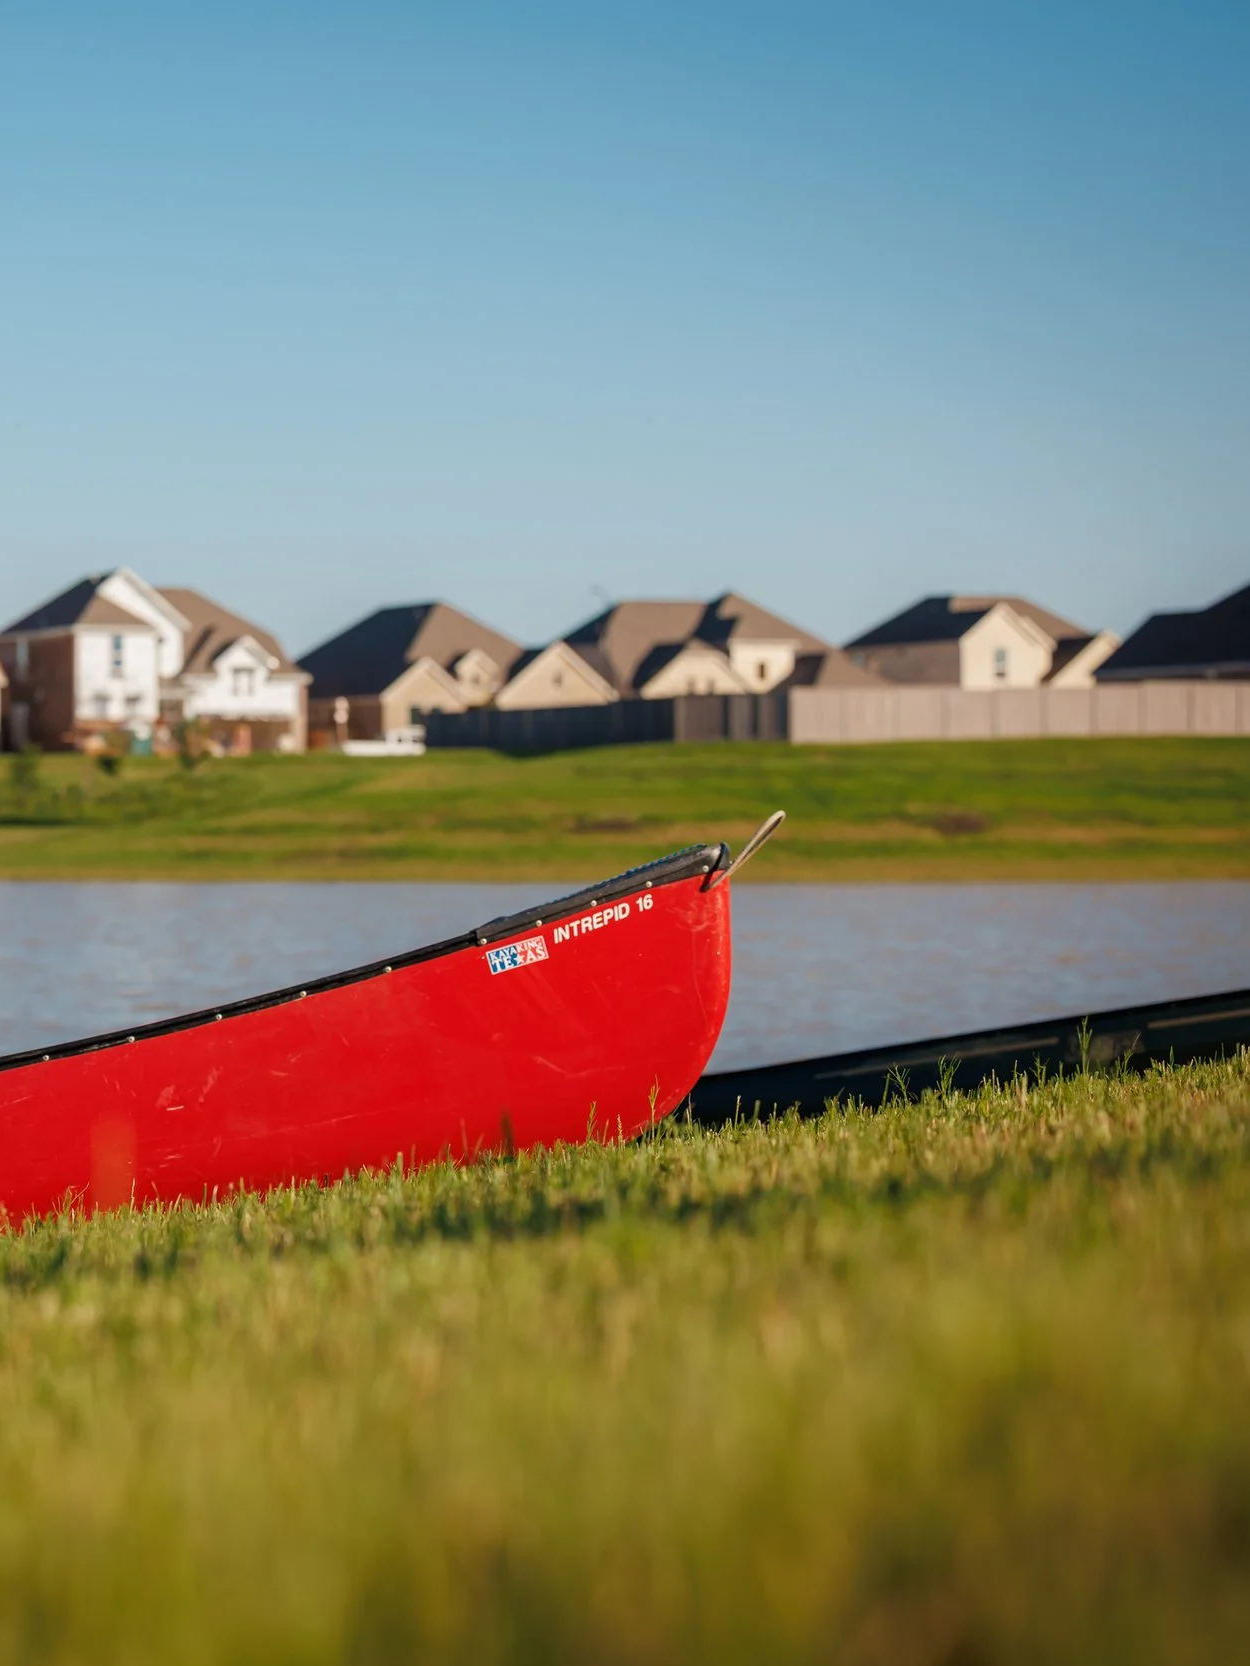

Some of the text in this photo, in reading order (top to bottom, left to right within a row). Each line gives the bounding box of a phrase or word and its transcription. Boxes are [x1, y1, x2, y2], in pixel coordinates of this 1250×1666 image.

[553, 894, 654, 944] INTREPID 16
[490, 938, 544, 960] KAYAKING
[491, 946, 546, 972] TEAS
